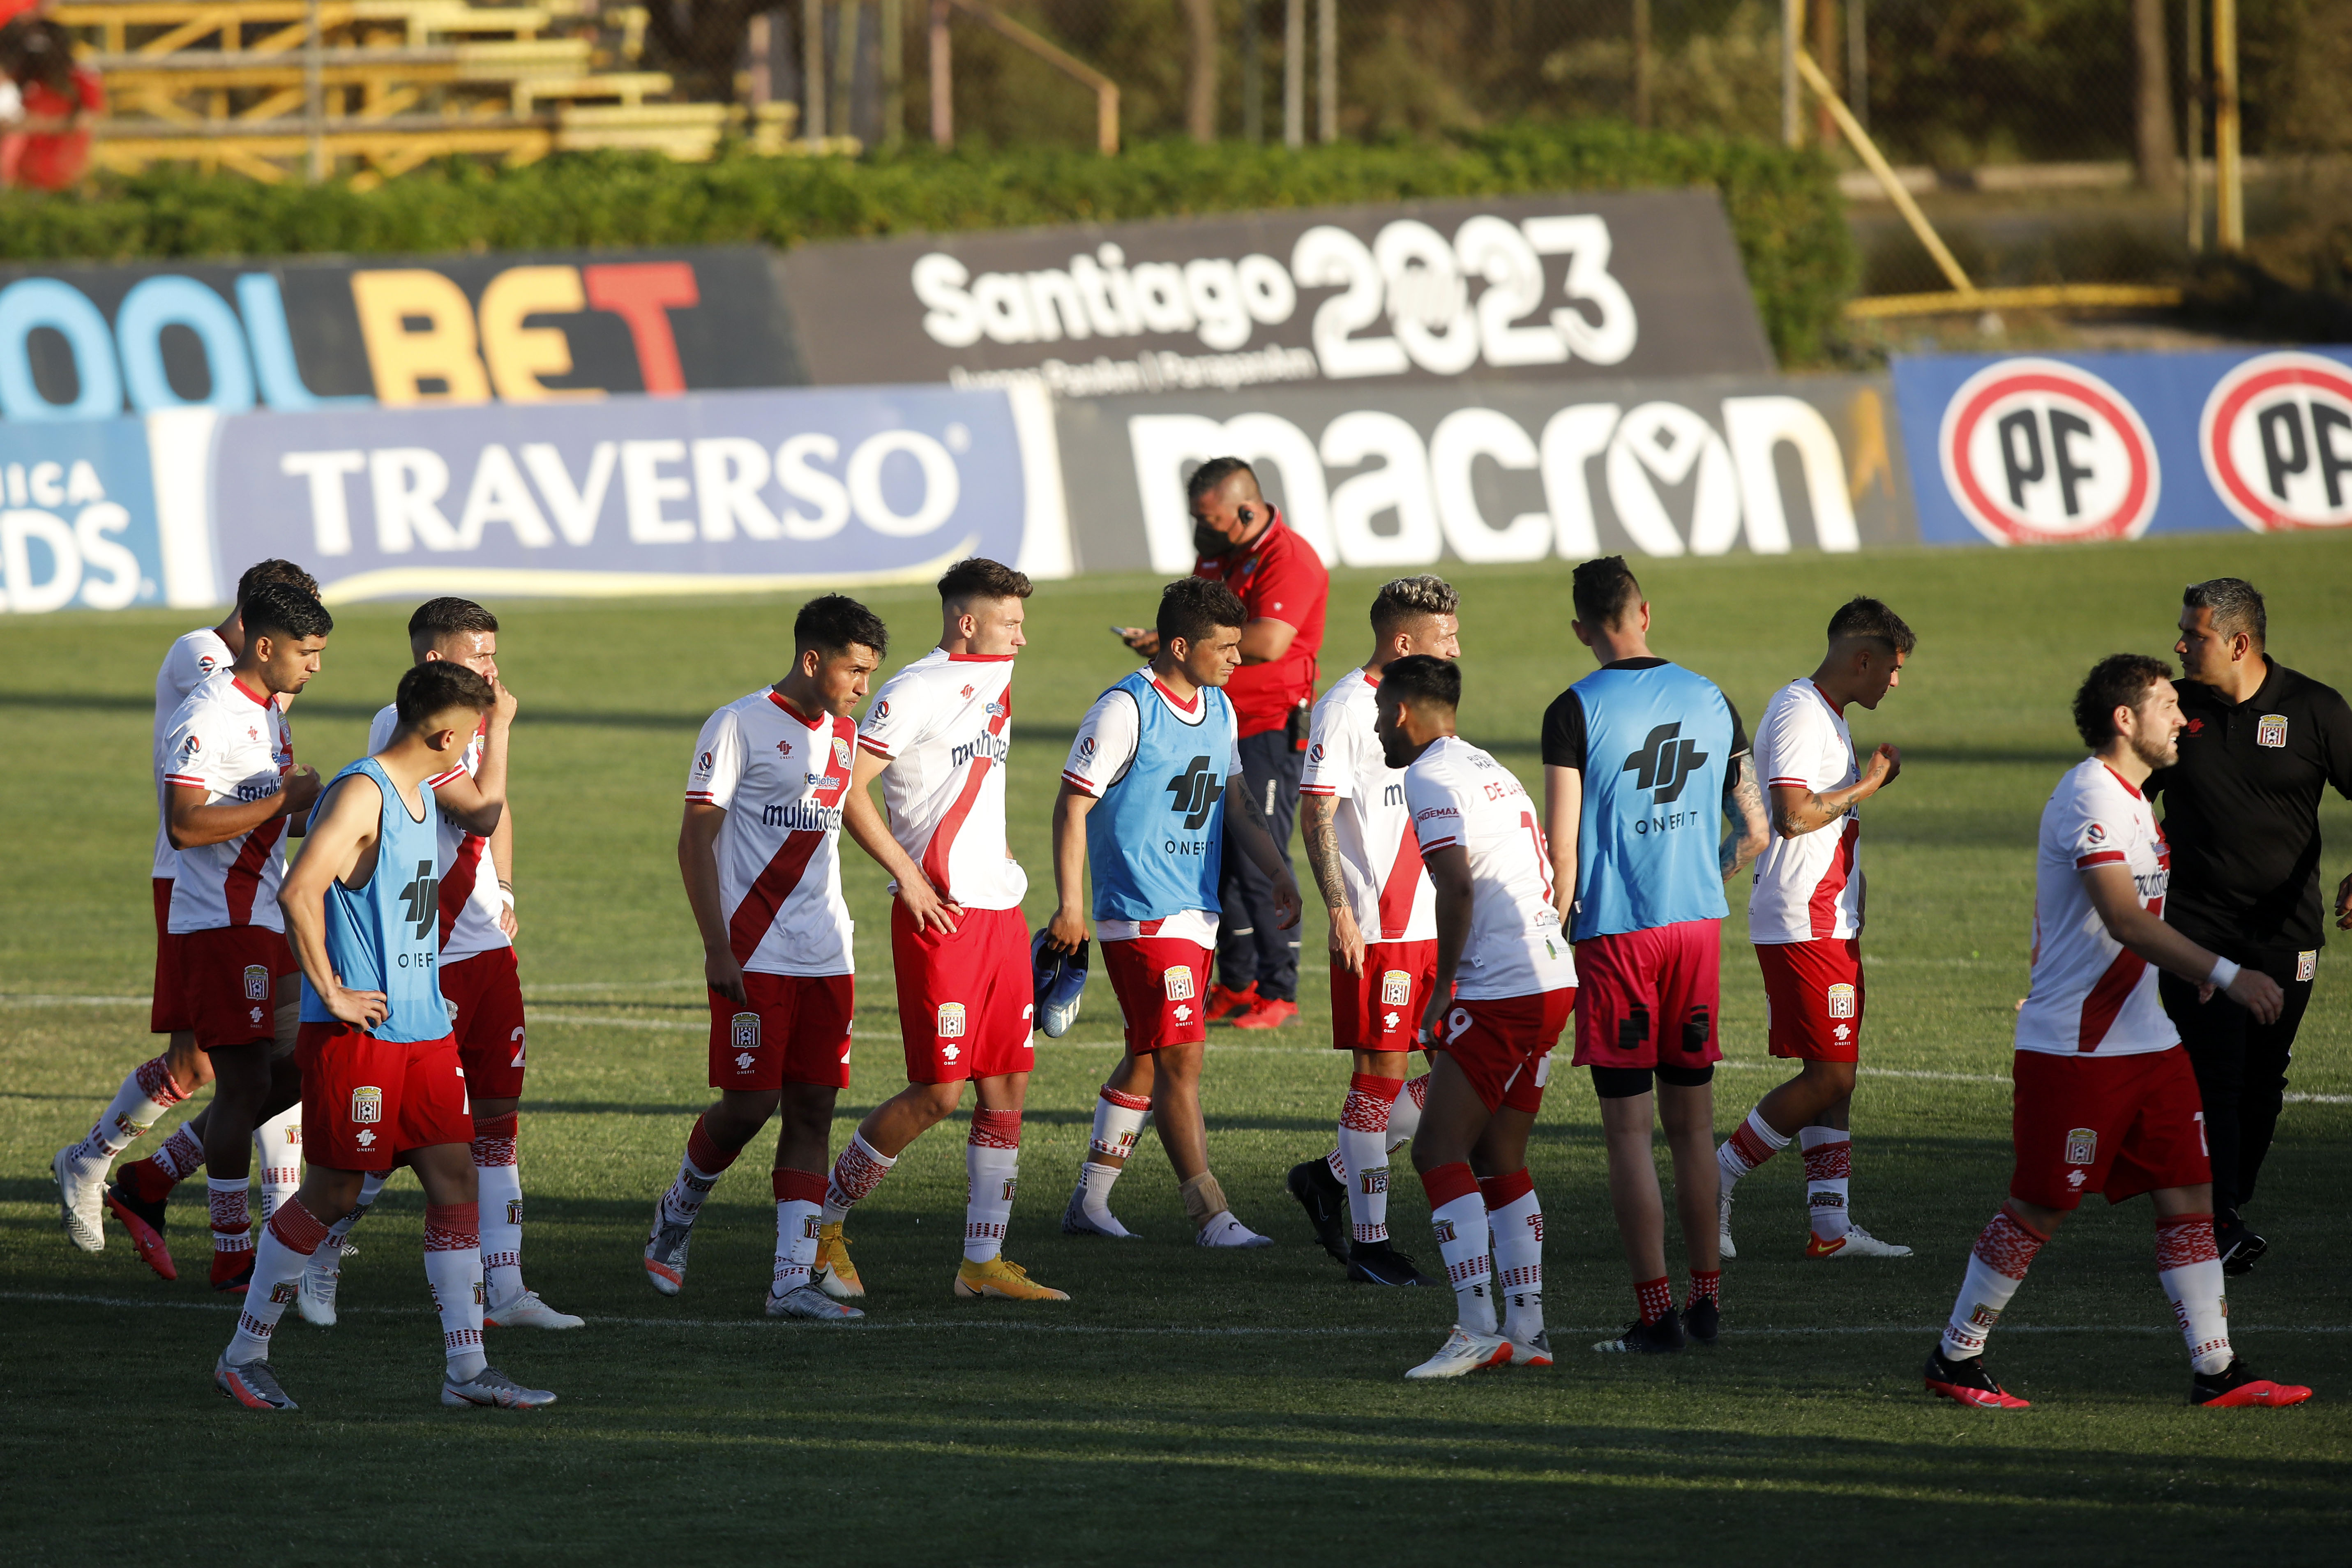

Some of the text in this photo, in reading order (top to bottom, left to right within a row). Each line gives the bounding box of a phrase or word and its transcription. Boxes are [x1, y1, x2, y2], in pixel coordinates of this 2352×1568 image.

[912, 214, 1637, 380] Santiago 2023
[0, 459, 106, 508] ICA
[279, 429, 960, 556] TRAVERSO
[1998, 408, 2093, 517] PF
[2258, 401, 2352, 508] PF
[0, 501, 141, 614] DS
[807, 773, 839, 786] eliotec
[1484, 782, 1505, 801] DE
[1165, 840, 1214, 855] ONEFIT
[1635, 811, 1698, 834] ONEFIT
